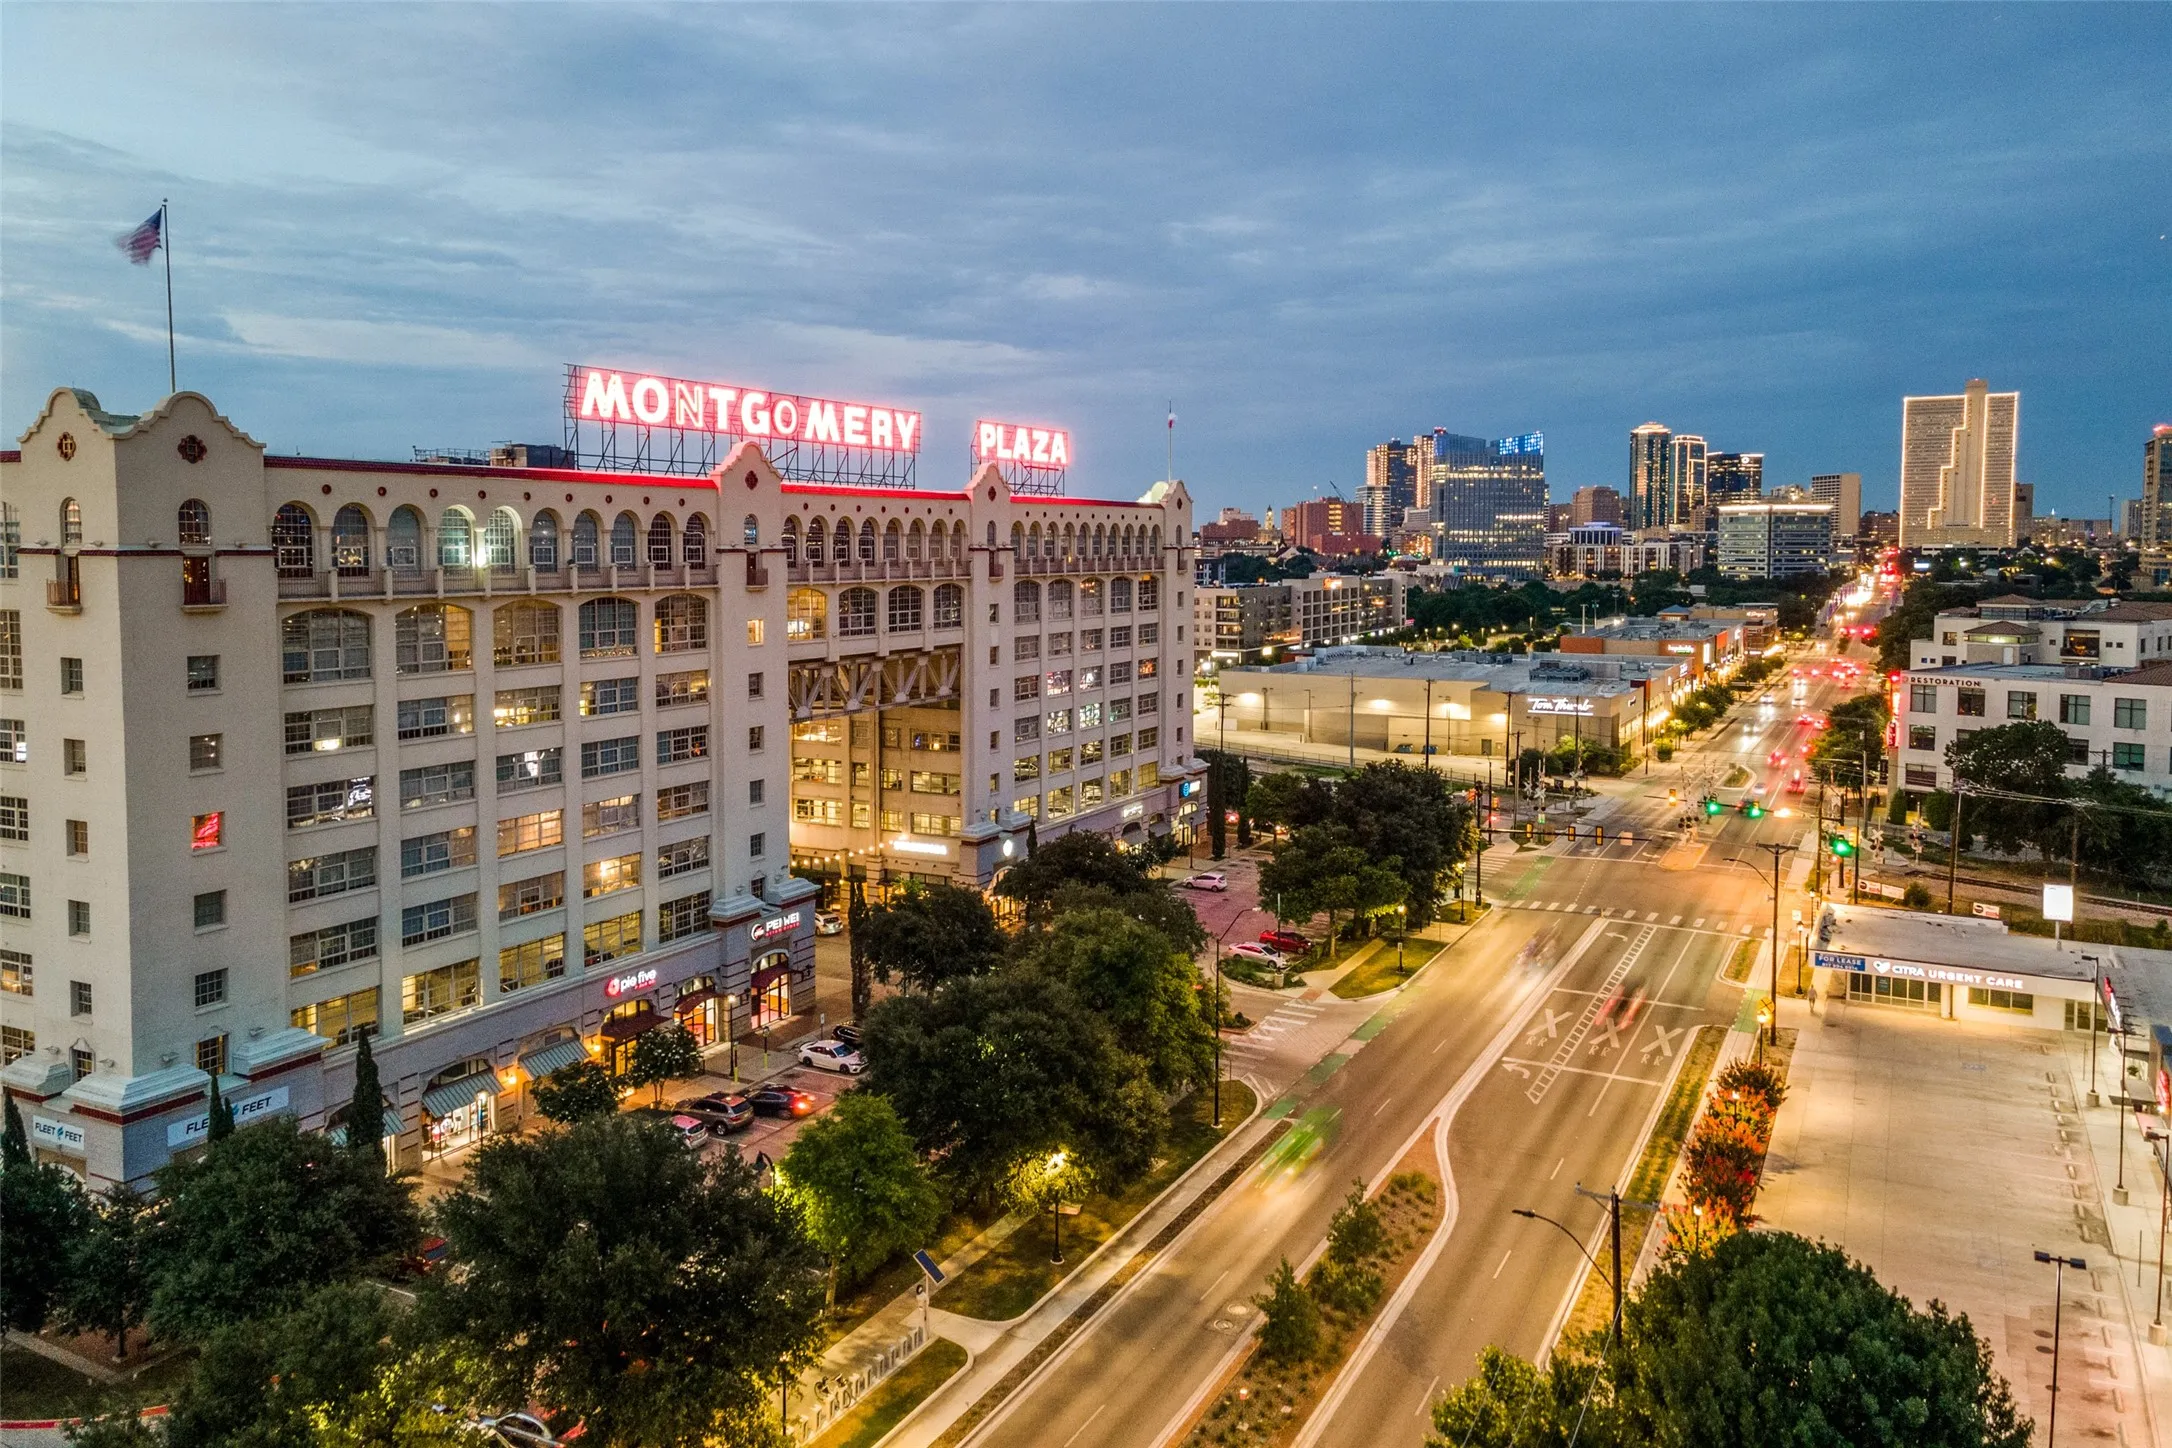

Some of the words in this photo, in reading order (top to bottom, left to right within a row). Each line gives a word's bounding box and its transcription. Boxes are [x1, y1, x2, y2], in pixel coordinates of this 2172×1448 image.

[580, 371, 917, 449] MONTGOMERY
[979, 423, 1067, 464] PLAZA
[1910, 676, 1981, 687] RESTORATION
[1528, 697, 1553, 710] Tom
[766, 918, 782, 931] PEI
[783, 912, 800, 926] WEI
[1837, 957, 1861, 966] LEASE
[620, 976, 637, 992] pie
[637, 970, 657, 984] five
[1928, 970, 1982, 985] URGENT
[1986, 976, 2024, 989] CARE
[186, 1117, 208, 1135] FLE
[242, 1097, 271, 1115] FEET
[35, 1122, 56, 1135] FLEET
[65, 1130, 82, 1143] FEET
